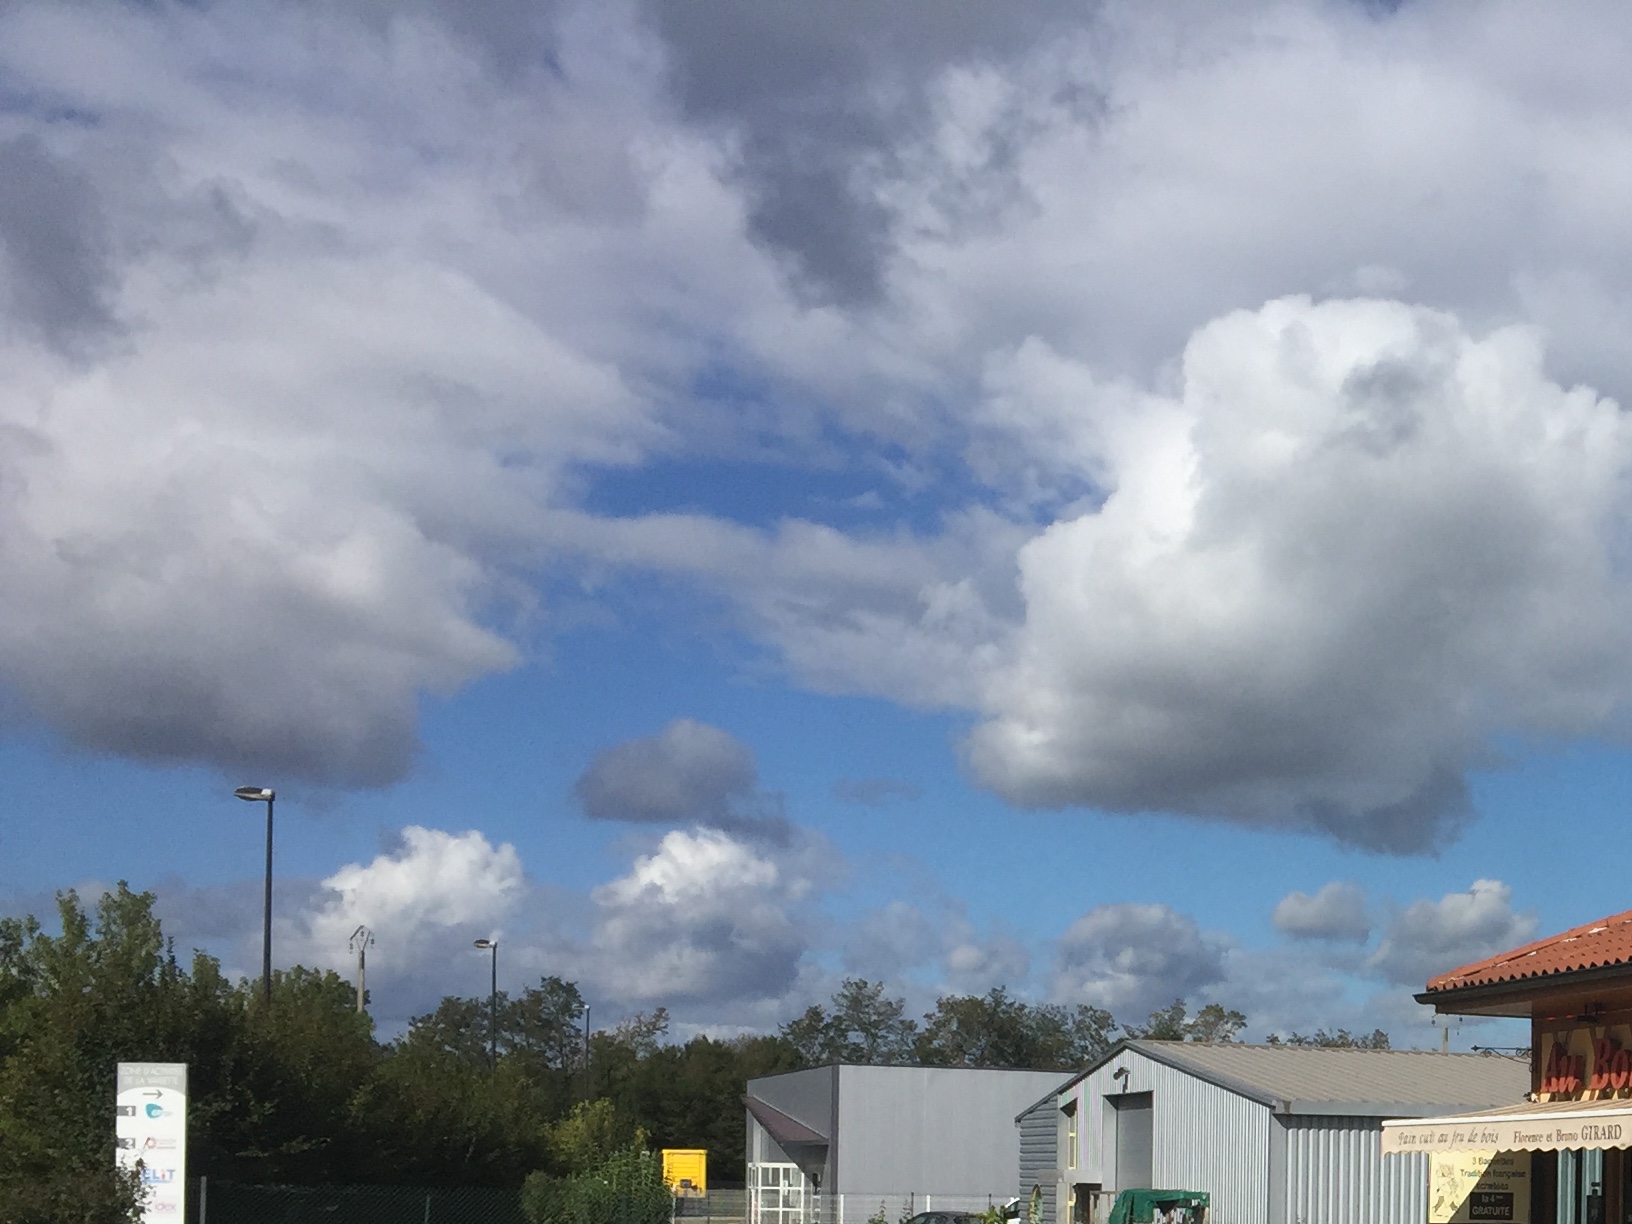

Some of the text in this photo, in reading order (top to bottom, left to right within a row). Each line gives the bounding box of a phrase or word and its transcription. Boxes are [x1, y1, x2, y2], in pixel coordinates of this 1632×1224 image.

[1540, 1041, 1583, 1092] Au
[126, 1107, 133, 1116] 1
[1467, 1126, 1478, 1144] de
[1480, 1126, 1499, 1145] bois
[1513, 1130, 1544, 1144] Florence
[1546, 1132, 1552, 1143] et
[1556, 1129, 1579, 1143] Bruno
[1581, 1124, 1623, 1141] GIRARD
[1472, 1157, 1477, 1165] 3
[1472, 1206, 1510, 1216] GRATUITE
